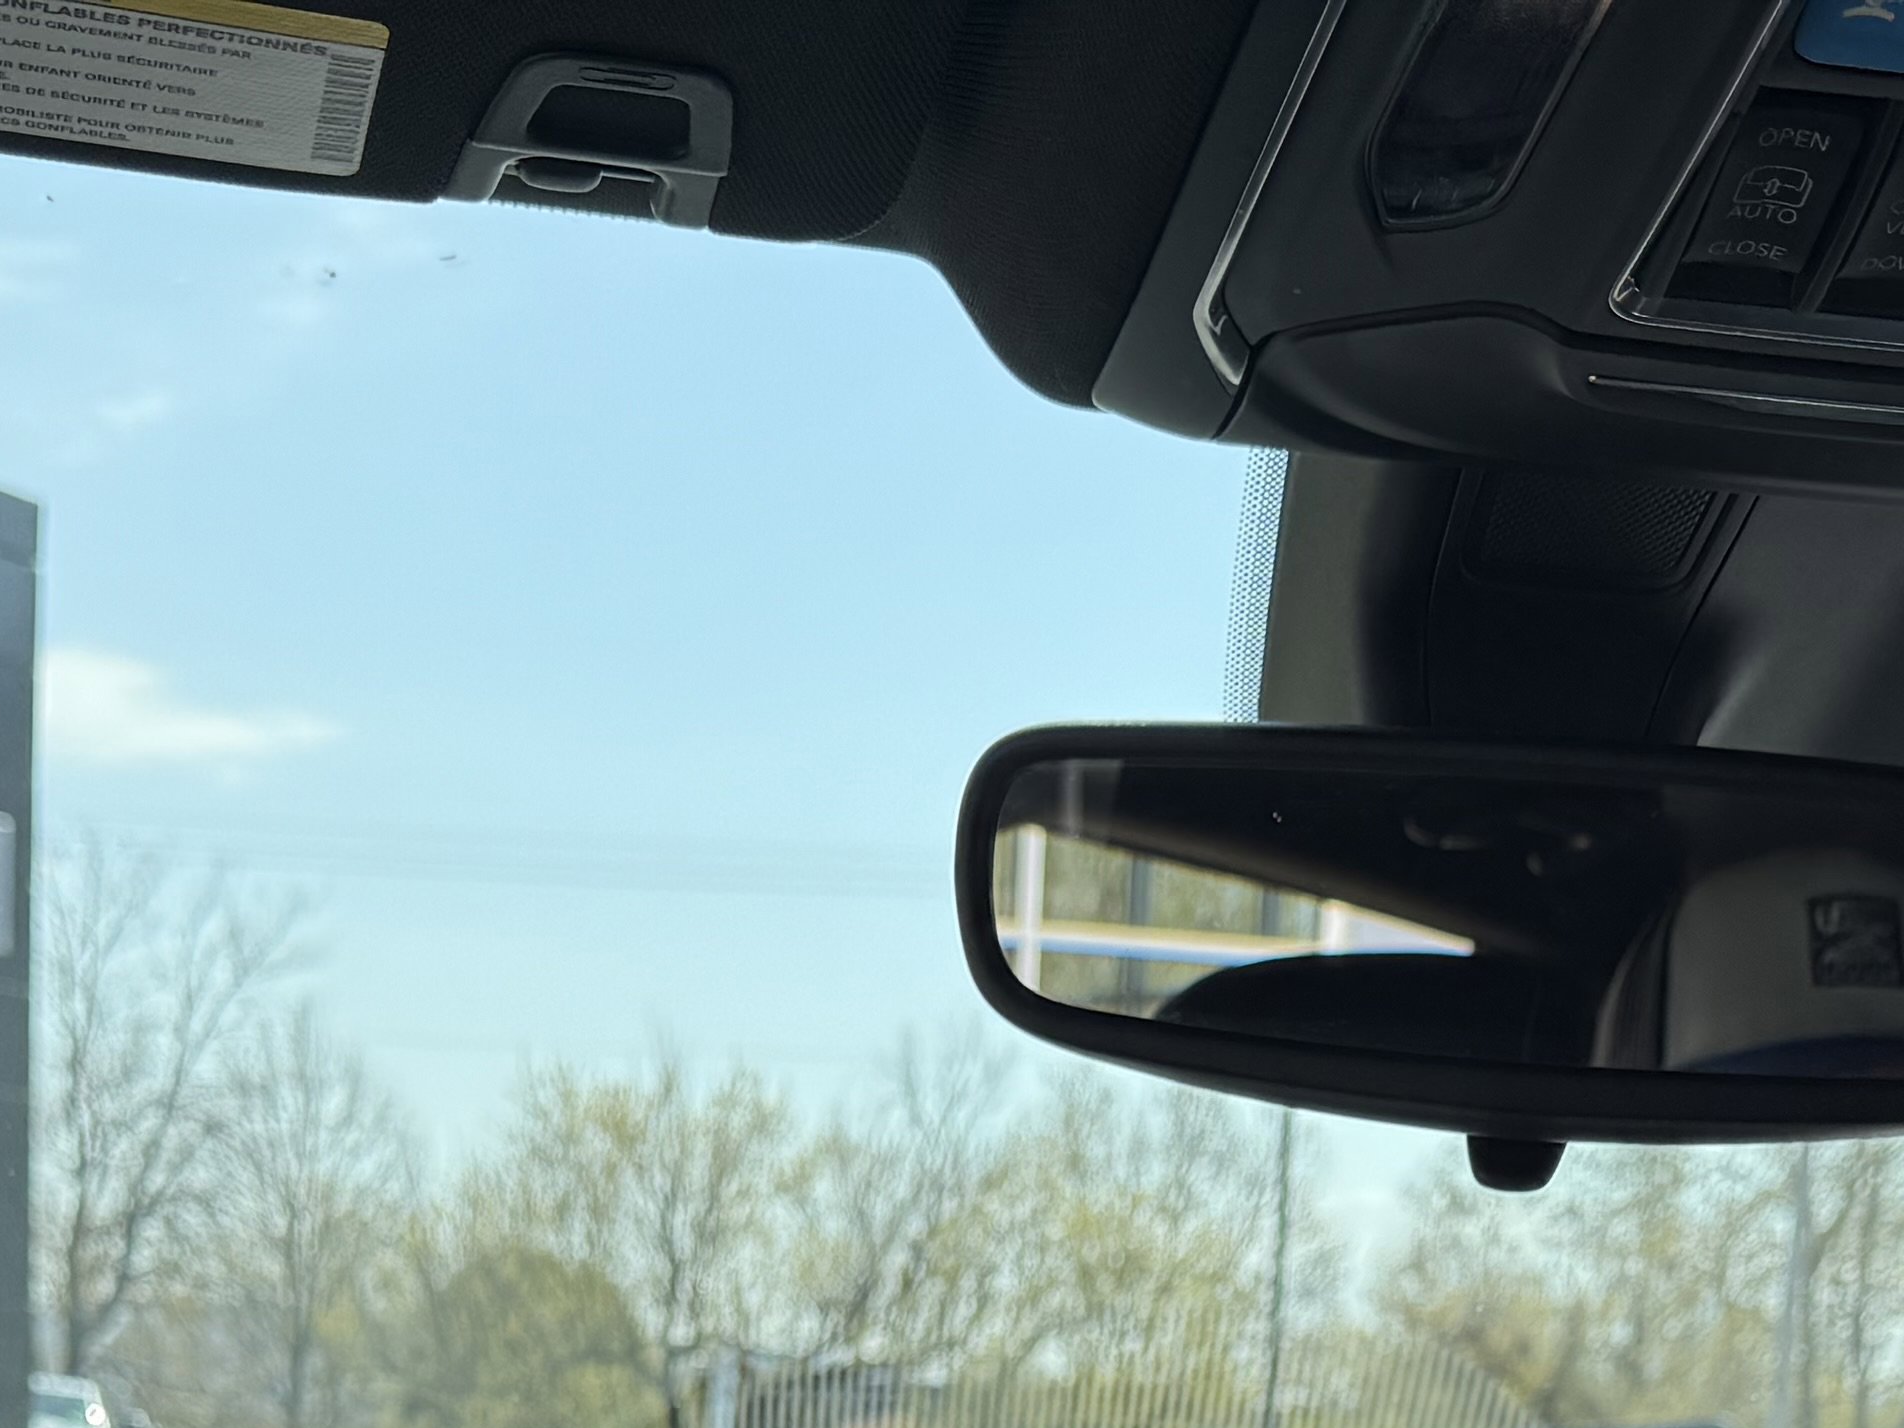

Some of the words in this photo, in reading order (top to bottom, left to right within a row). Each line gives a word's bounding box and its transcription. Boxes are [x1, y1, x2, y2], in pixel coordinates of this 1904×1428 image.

[44, 20, 142, 43] GRAVEMENT
[221, 46, 252, 60] PAR
[138, 18, 327, 57] PERFECTIONNÉS
[46, 43, 66, 54] LA
[71, 46, 112, 60] PLUS
[18, 63, 80, 80] ENFANT
[84, 71, 152, 91] ORIENTÉ
[26, 86, 46, 97] DE
[130, 101, 148, 111] ET
[1758, 127, 1831, 154] OPEN
[1726, 203, 1798, 226] AUTO
[1707, 239, 1788, 263] CLOSE
